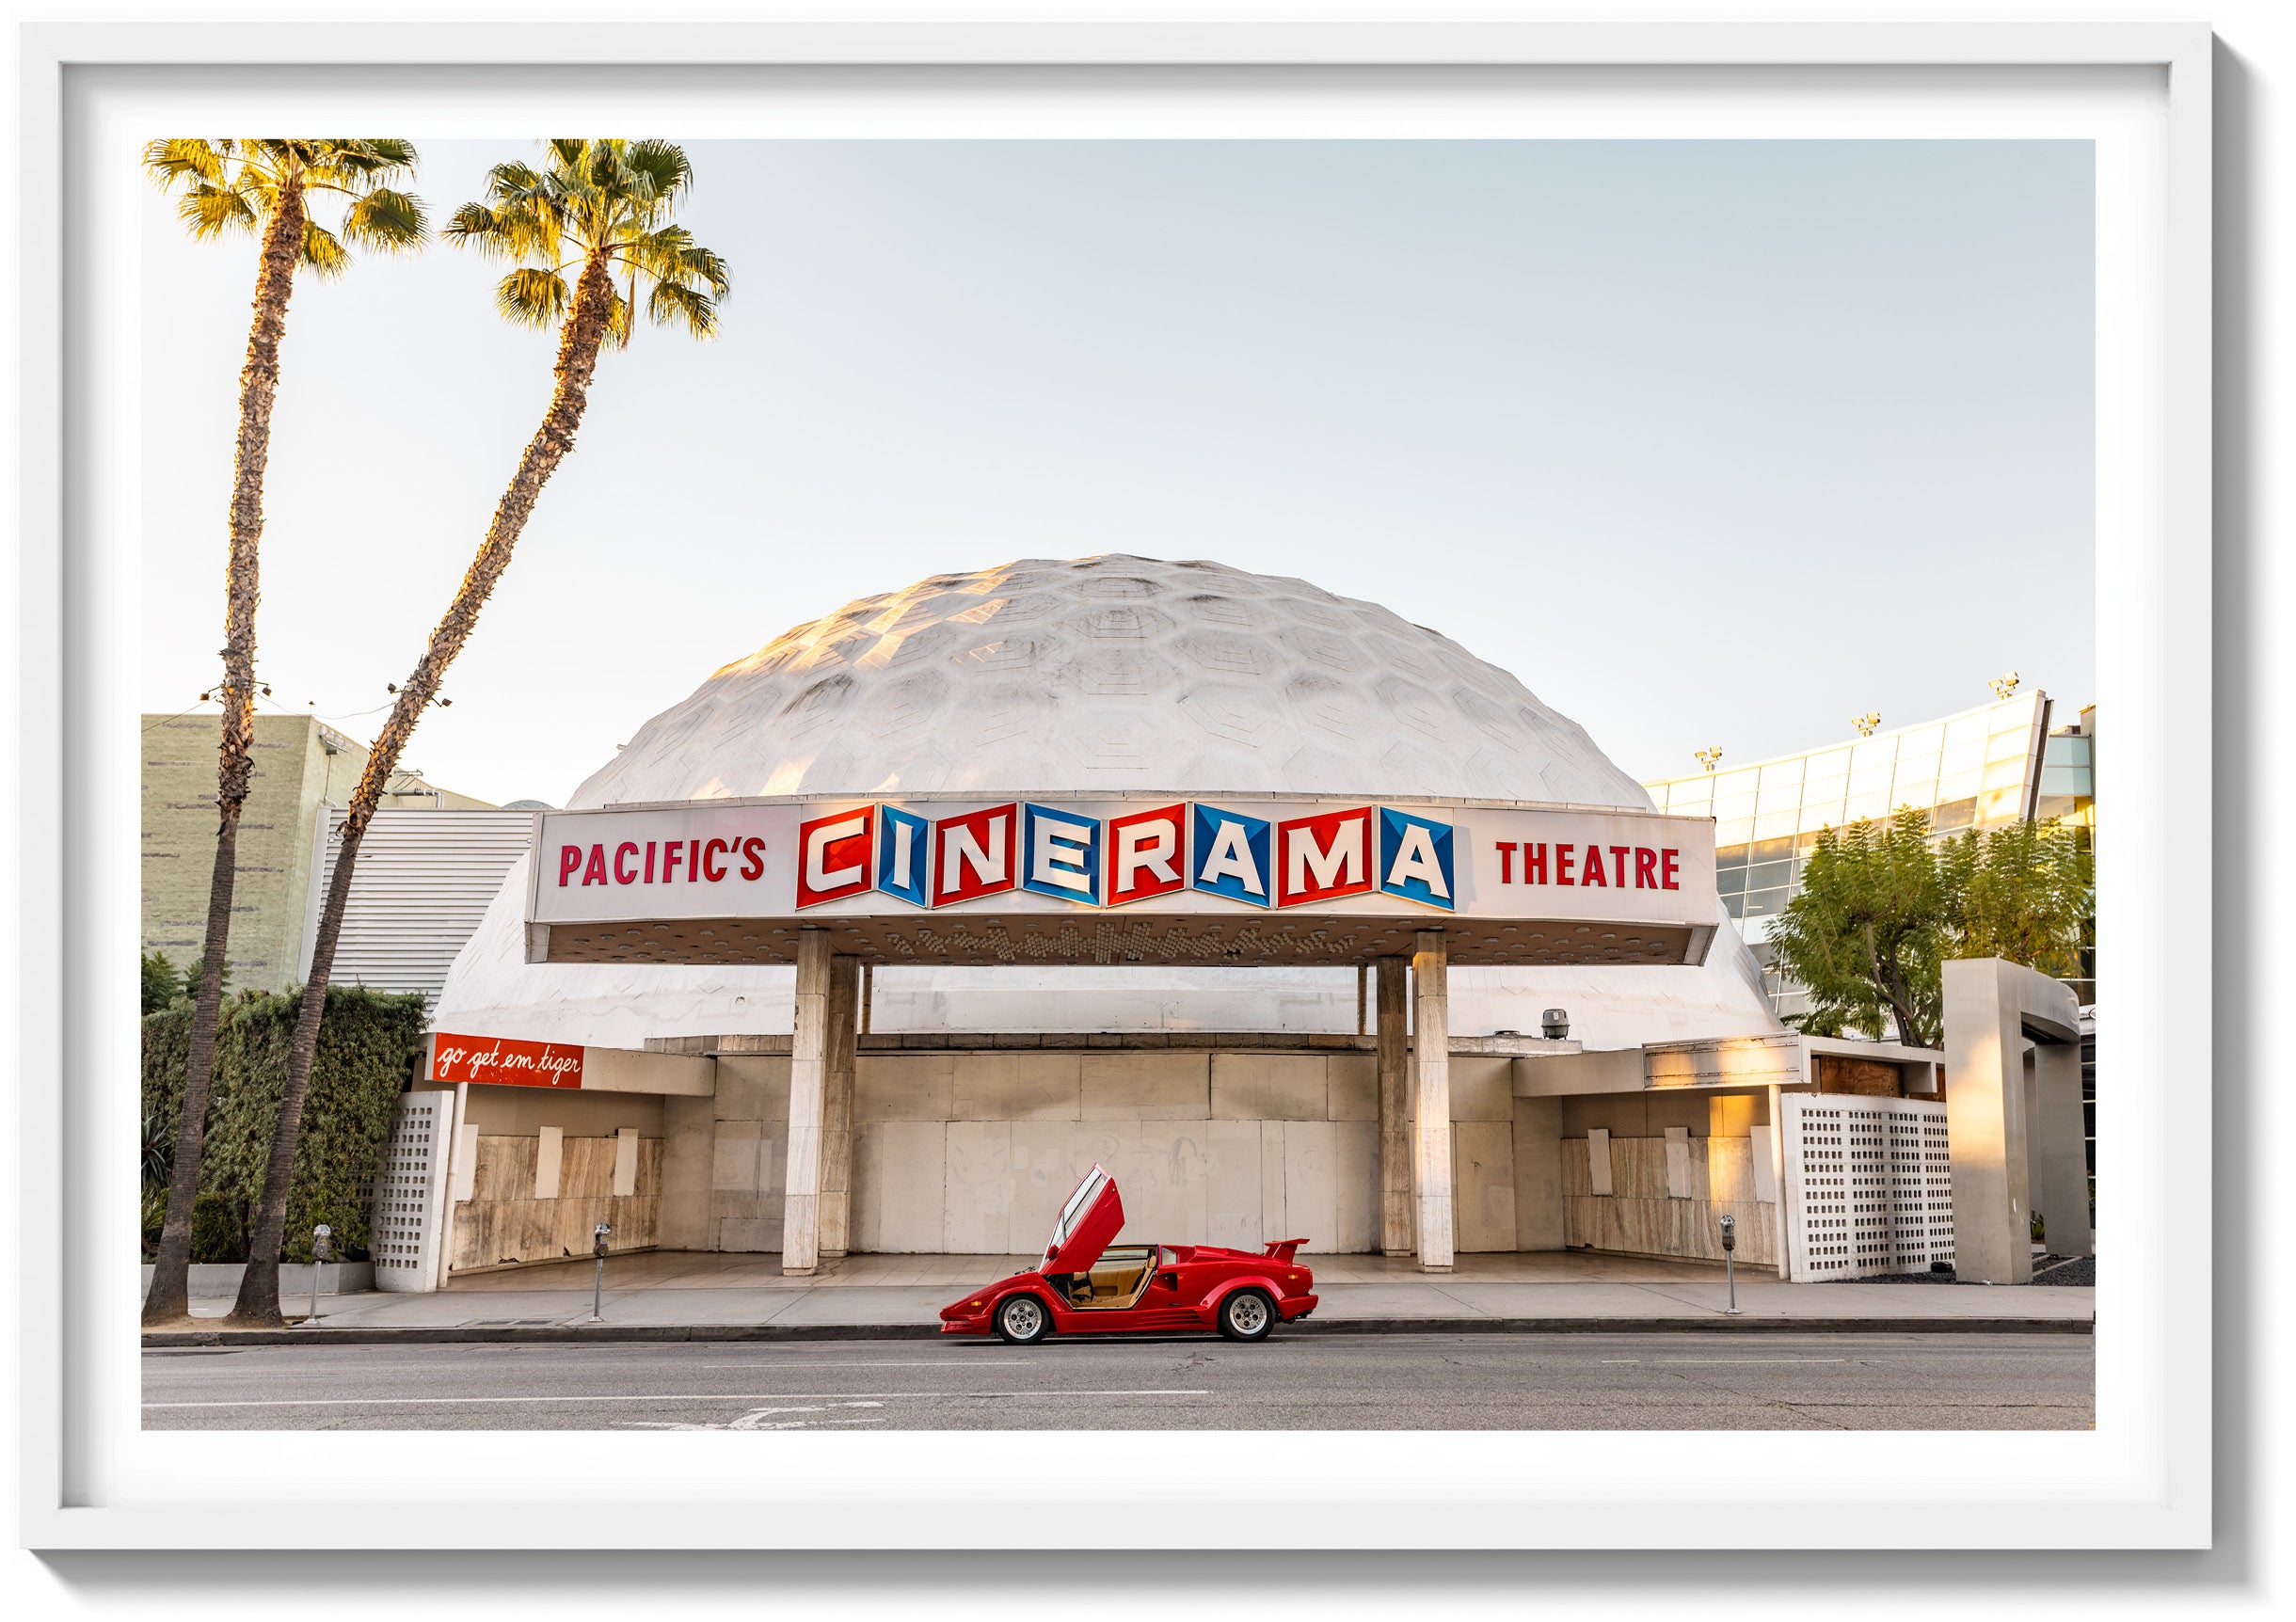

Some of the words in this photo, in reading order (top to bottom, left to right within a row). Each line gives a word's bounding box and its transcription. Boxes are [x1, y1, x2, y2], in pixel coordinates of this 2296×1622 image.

[559, 836, 766, 886] PACIFIC'S
[807, 816, 1451, 898] CINERAMA
[1495, 841, 1680, 890] THEATRE
[438, 1047, 467, 1077] go
[467, 1040, 500, 1079] get
[501, 1053, 535, 1070] em
[537, 1044, 581, 1085] tiger
